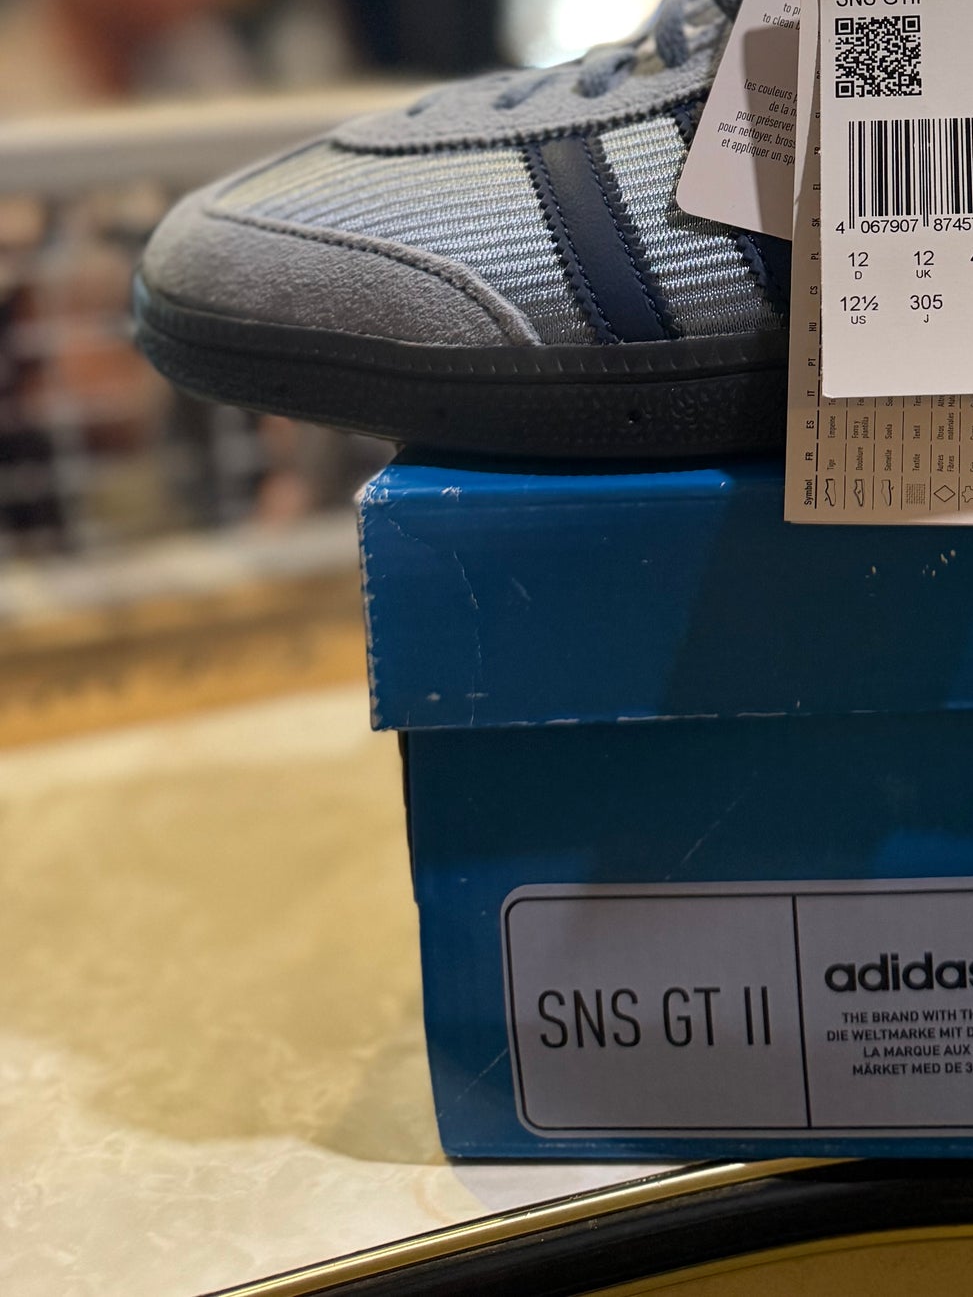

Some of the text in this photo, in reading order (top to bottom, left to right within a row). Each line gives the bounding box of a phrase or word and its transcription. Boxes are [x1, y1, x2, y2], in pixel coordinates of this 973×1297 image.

[784, 3, 791, 13] to
[762, 13, 771, 23] to
[772, 15, 794, 29] clean
[744, 78, 756, 91] les
[758, 84, 792, 100] couleurs
[769, 102, 779, 113] de
[780, 104, 788, 115] la
[736, 110, 794, 132] pour préserver
[718, 122, 737, 133] pour
[738, 126, 773, 144] nettoyer,
[721, 138, 730, 148] et
[731, 141, 770, 158] appliquer
[770, 151, 781, 161] un
[812, 218, 820, 227] SK
[835, 221, 845, 234] 4
[861, 219, 919, 233] 067907
[811, 252, 819, 260] PL
[848, 252, 869, 267] 12
[913, 250, 934, 266] 12
[854, 271, 862, 280] D
[916, 270, 932, 278] UK
[810, 285, 818, 295] CS
[910, 294, 943, 310] 305
[850, 316, 866, 324] US
[923, 314, 929, 323] J
[809, 322, 817, 332] HU
[808, 358, 816, 366] PT
[806, 420, 815, 429] ES
[828, 415, 837, 439] Empeine
[805, 452, 813, 461] FR
[856, 446, 864, 471] Doublure
[884, 449, 892, 471] Semelle
[912, 454, 920, 472] Textile
[936, 454, 944, 472] Autres
[827, 459, 836, 470] Tige
[804, 479, 814, 505] Symbol
[538, 985, 772, 1049] SNS GT II
[842, 1011, 868, 1023] THE
[872, 1010, 919, 1022] BRAND
[922, 1009, 957, 1022] WITH
[826, 1030, 848, 1042] DIE
[852, 1027, 935, 1040] WELTMARKE
[940, 1026, 962, 1039] MIT
[864, 1046, 880, 1058] LA
[884, 1045, 940, 1057] MARQUE
[944, 1044, 971, 1056] AUX
[852, 1062, 908, 1076] MÄRKET
[912, 1063, 940, 1075] MED
[945, 1062, 962, 1074] DE
[966, 1062, 973, 1073] 3
